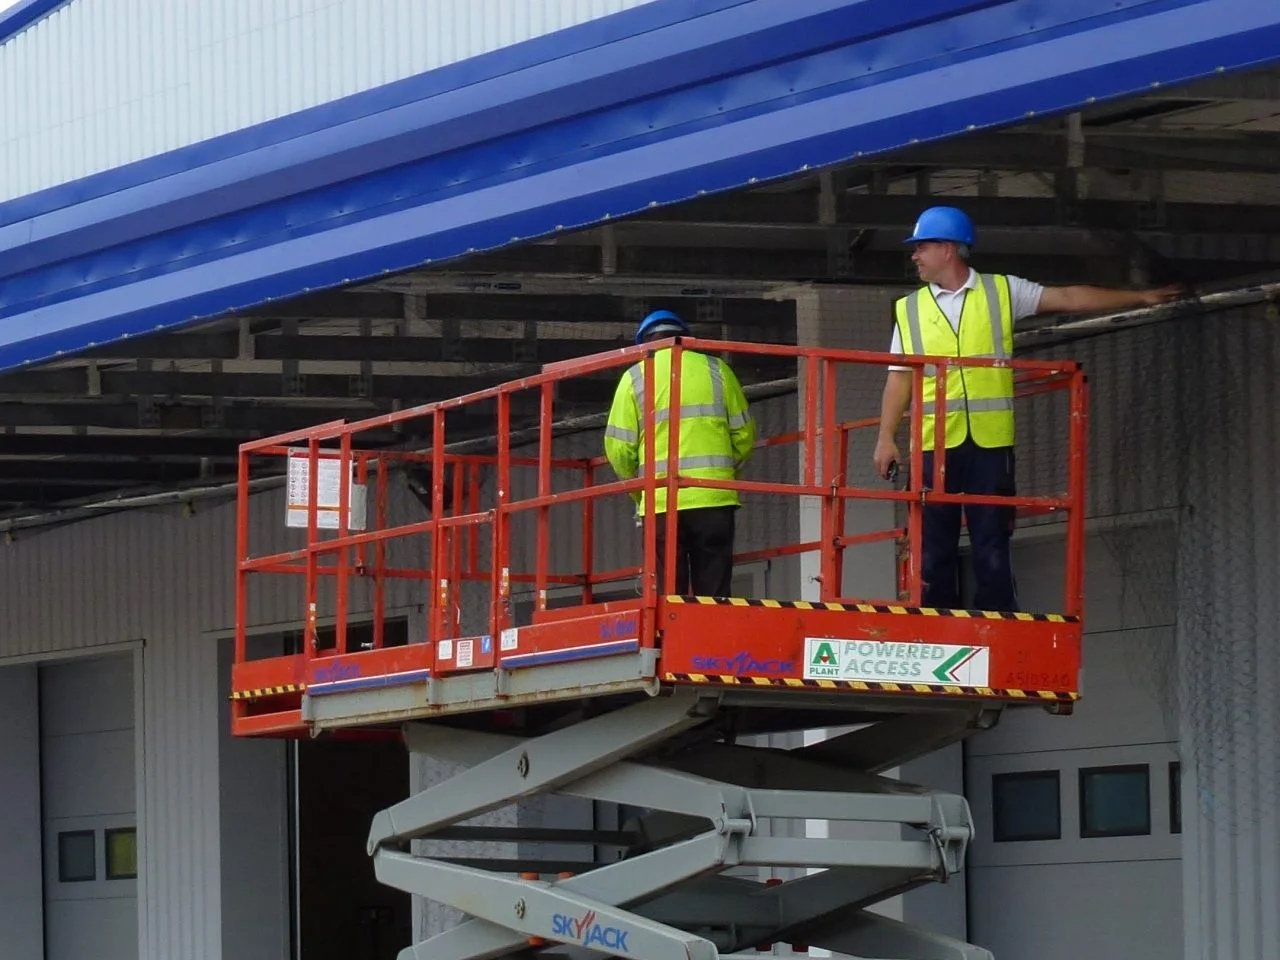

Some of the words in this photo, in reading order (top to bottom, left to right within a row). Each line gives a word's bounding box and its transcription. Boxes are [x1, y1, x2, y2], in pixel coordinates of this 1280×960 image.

[811, 642, 838, 666] A
[844, 641, 946, 660] POWERED
[692, 650, 796, 675] SKYJACK
[809, 667, 840, 677] PLANT
[844, 658, 922, 677] ACCESS
[552, 909, 629, 953] SKYJACK
